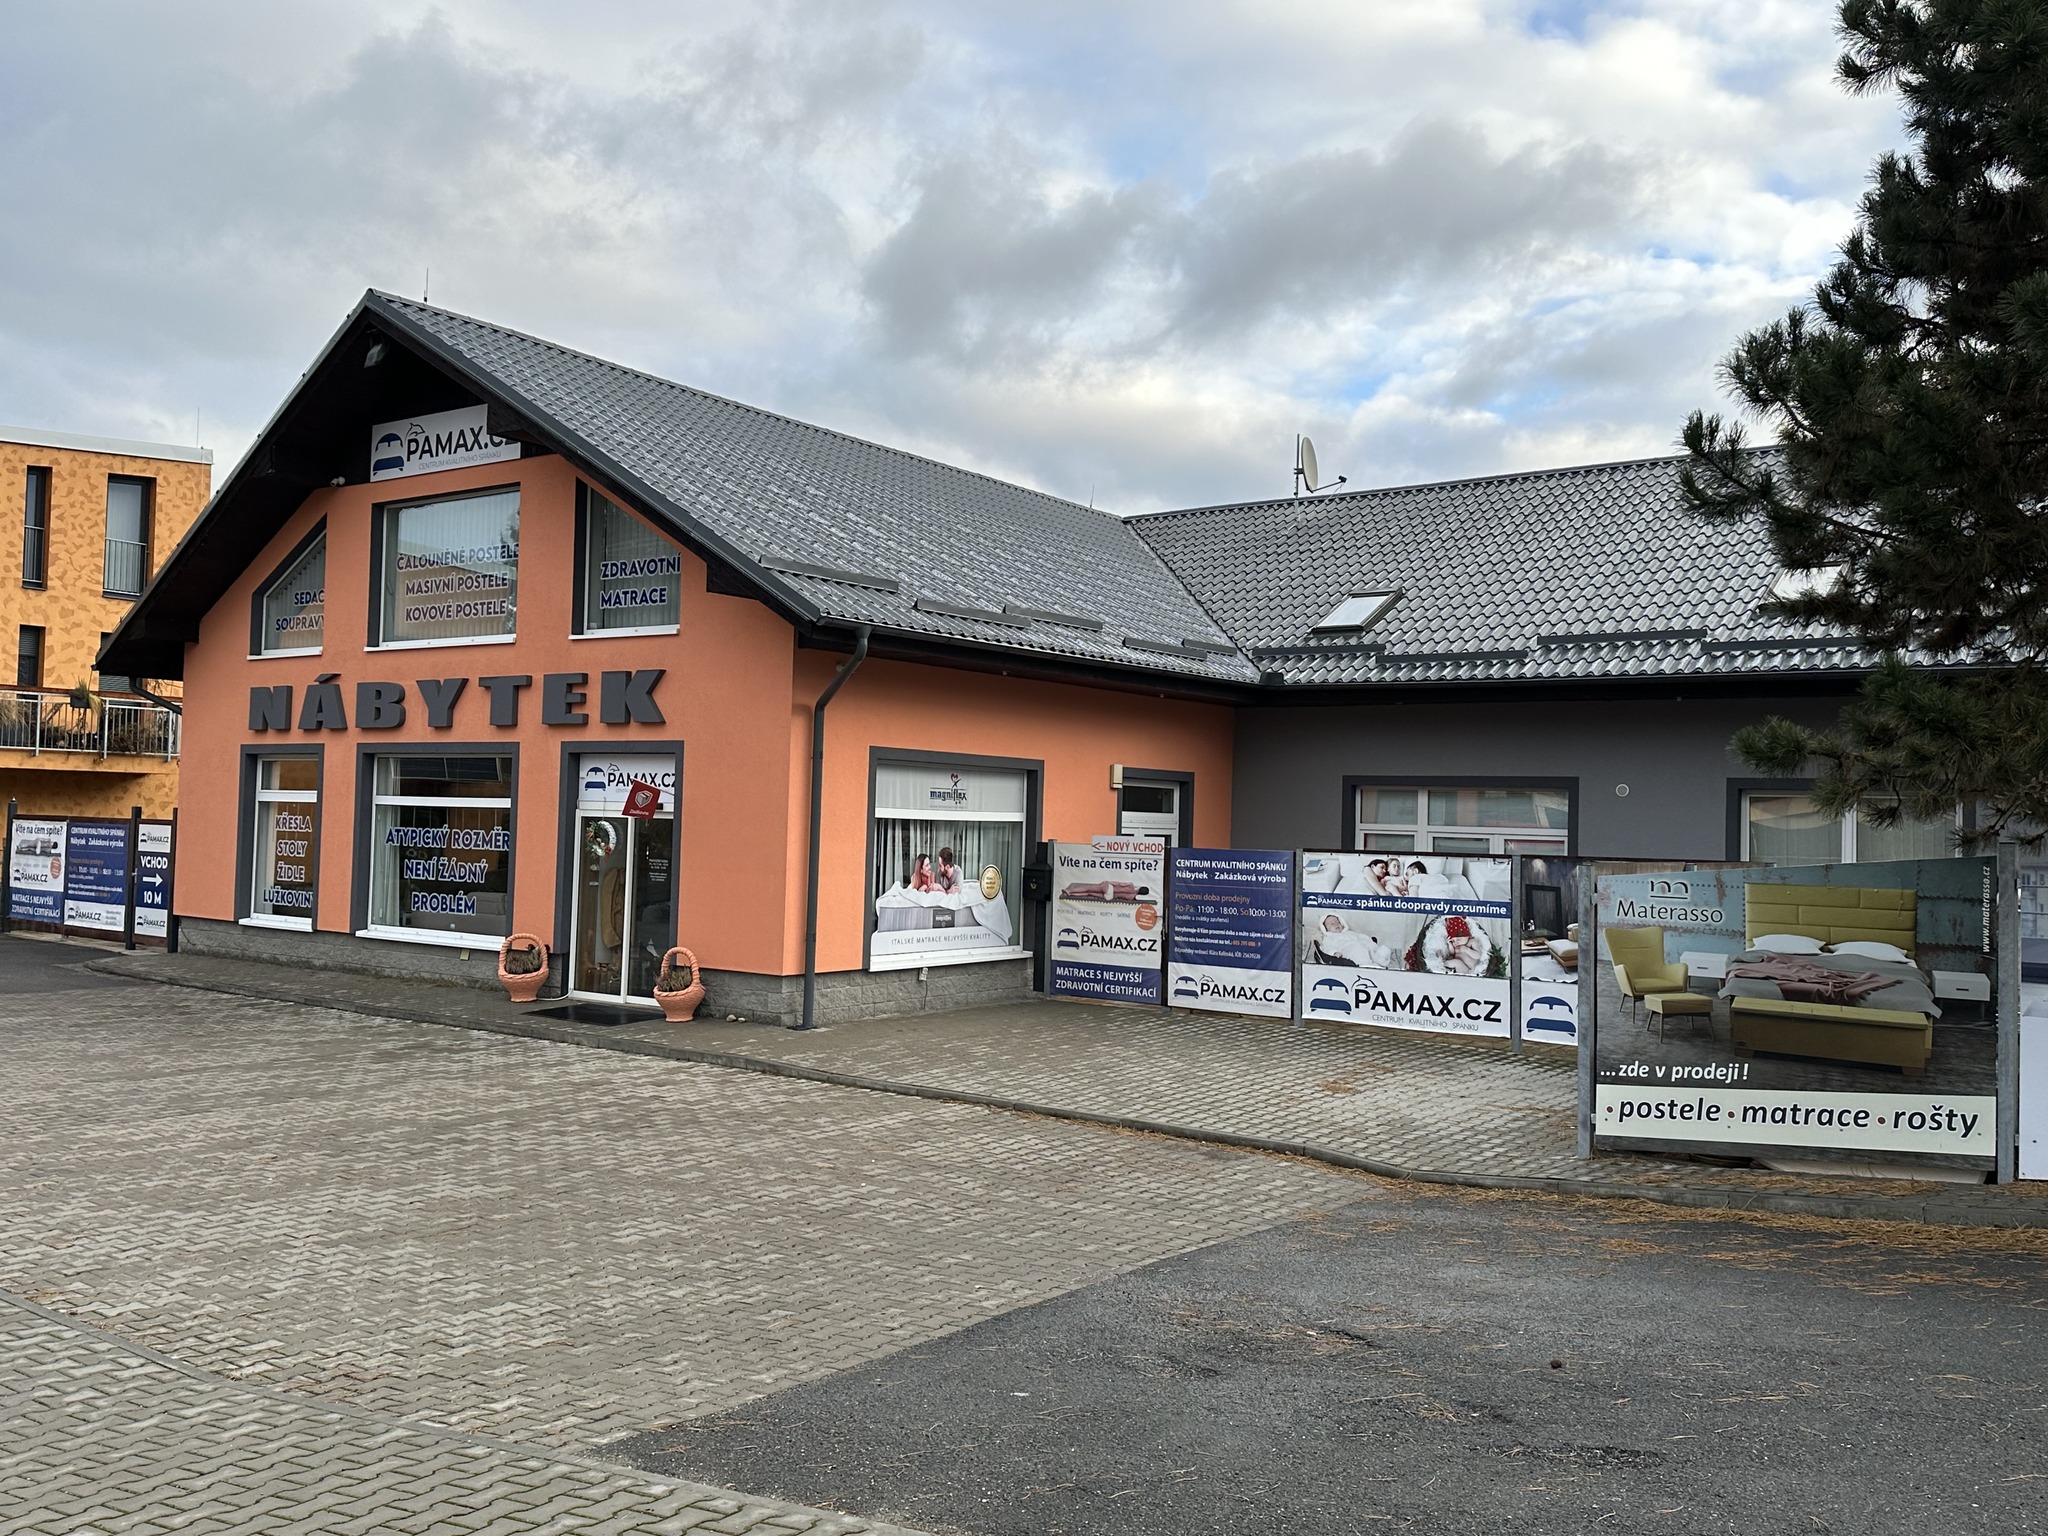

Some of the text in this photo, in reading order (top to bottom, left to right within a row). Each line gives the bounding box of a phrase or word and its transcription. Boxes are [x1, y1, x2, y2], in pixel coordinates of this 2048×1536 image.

[407, 425, 518, 462] PAMAX.C
[418, 451, 502, 471] CENTRUM KVALITNÍHO SPÁNKU
[397, 544, 519, 571] ČALOUNĚNÉ POSTELE
[602, 552, 681, 579] ZDRAVOTNÍ
[406, 572, 508, 596] MASIVNÍ POSTELE
[600, 588, 667, 607] MATRACE
[405, 600, 506, 622] KOVOVÉ POSTELE
[248, 669, 666, 730] NÁBYTEK
[930, 789, 967, 801] magniflex
[26, 826, 33, 834] na
[34, 825, 45, 835] čem
[275, 813, 312, 831] KŘESLA
[386, 825, 510, 850] ATYPICKÝ ROZMĚR
[1107, 839, 1164, 854] NOVÝ VCHOD
[277, 841, 307, 857] STOLY
[140, 855, 168, 869] VCHOD
[404, 857, 488, 882] NENÍ ŽÁDNÝ
[1059, 855, 1158, 873] Víte na čem spíte?
[1176, 859, 1287, 871] CENTRUM KVALITNÍHO SPÁNKU
[21, 872, 48, 882] PAMAX.CZ
[277, 862, 304, 881] ŽIDLE
[1176, 870, 1286, 884] Nábytek Zakázková výroba
[144, 891, 162, 905] 10 M
[263, 886, 313, 907] LŮŽKOVIN
[412, 891, 476, 915] PROBLÉM
[1175, 892, 1251, 904] Provozní doba prodejny
[1197, 905, 1214, 914] 11:00
[1318, 897, 1507, 915] PAMAX.CZ spánku doopravdy rozumíme
[1616, 899, 1723, 923] Materasso
[1982, 866, 1991, 953] www.materasso.cz
[75, 911, 101, 921] PAMAX.CZ
[143, 919, 166, 928] PAMAX.CZ
[891, 932, 991, 946] ITALSKÉ MATRACE NEJVYŠŠÍ KVALITY
[1081, 934, 1158, 952] PAMAX.CZ
[1056, 967, 1143, 983] MATRACE S NEJVYŠŠÍ
[1055, 980, 1157, 998] ZDRAVOTNÍ CERTIFIKACÍ
[1200, 983, 1286, 1003] PAMAX.CZ
[1354, 989, 1502, 1023] PAMAX.CZ
[1372, 1014, 1479, 1031] CENTRUM KVALITNÍHO SPÁNKU
[1655, 1065, 1666, 1078] v
[1619, 1097, 1979, 1138] postele matrace rošty
